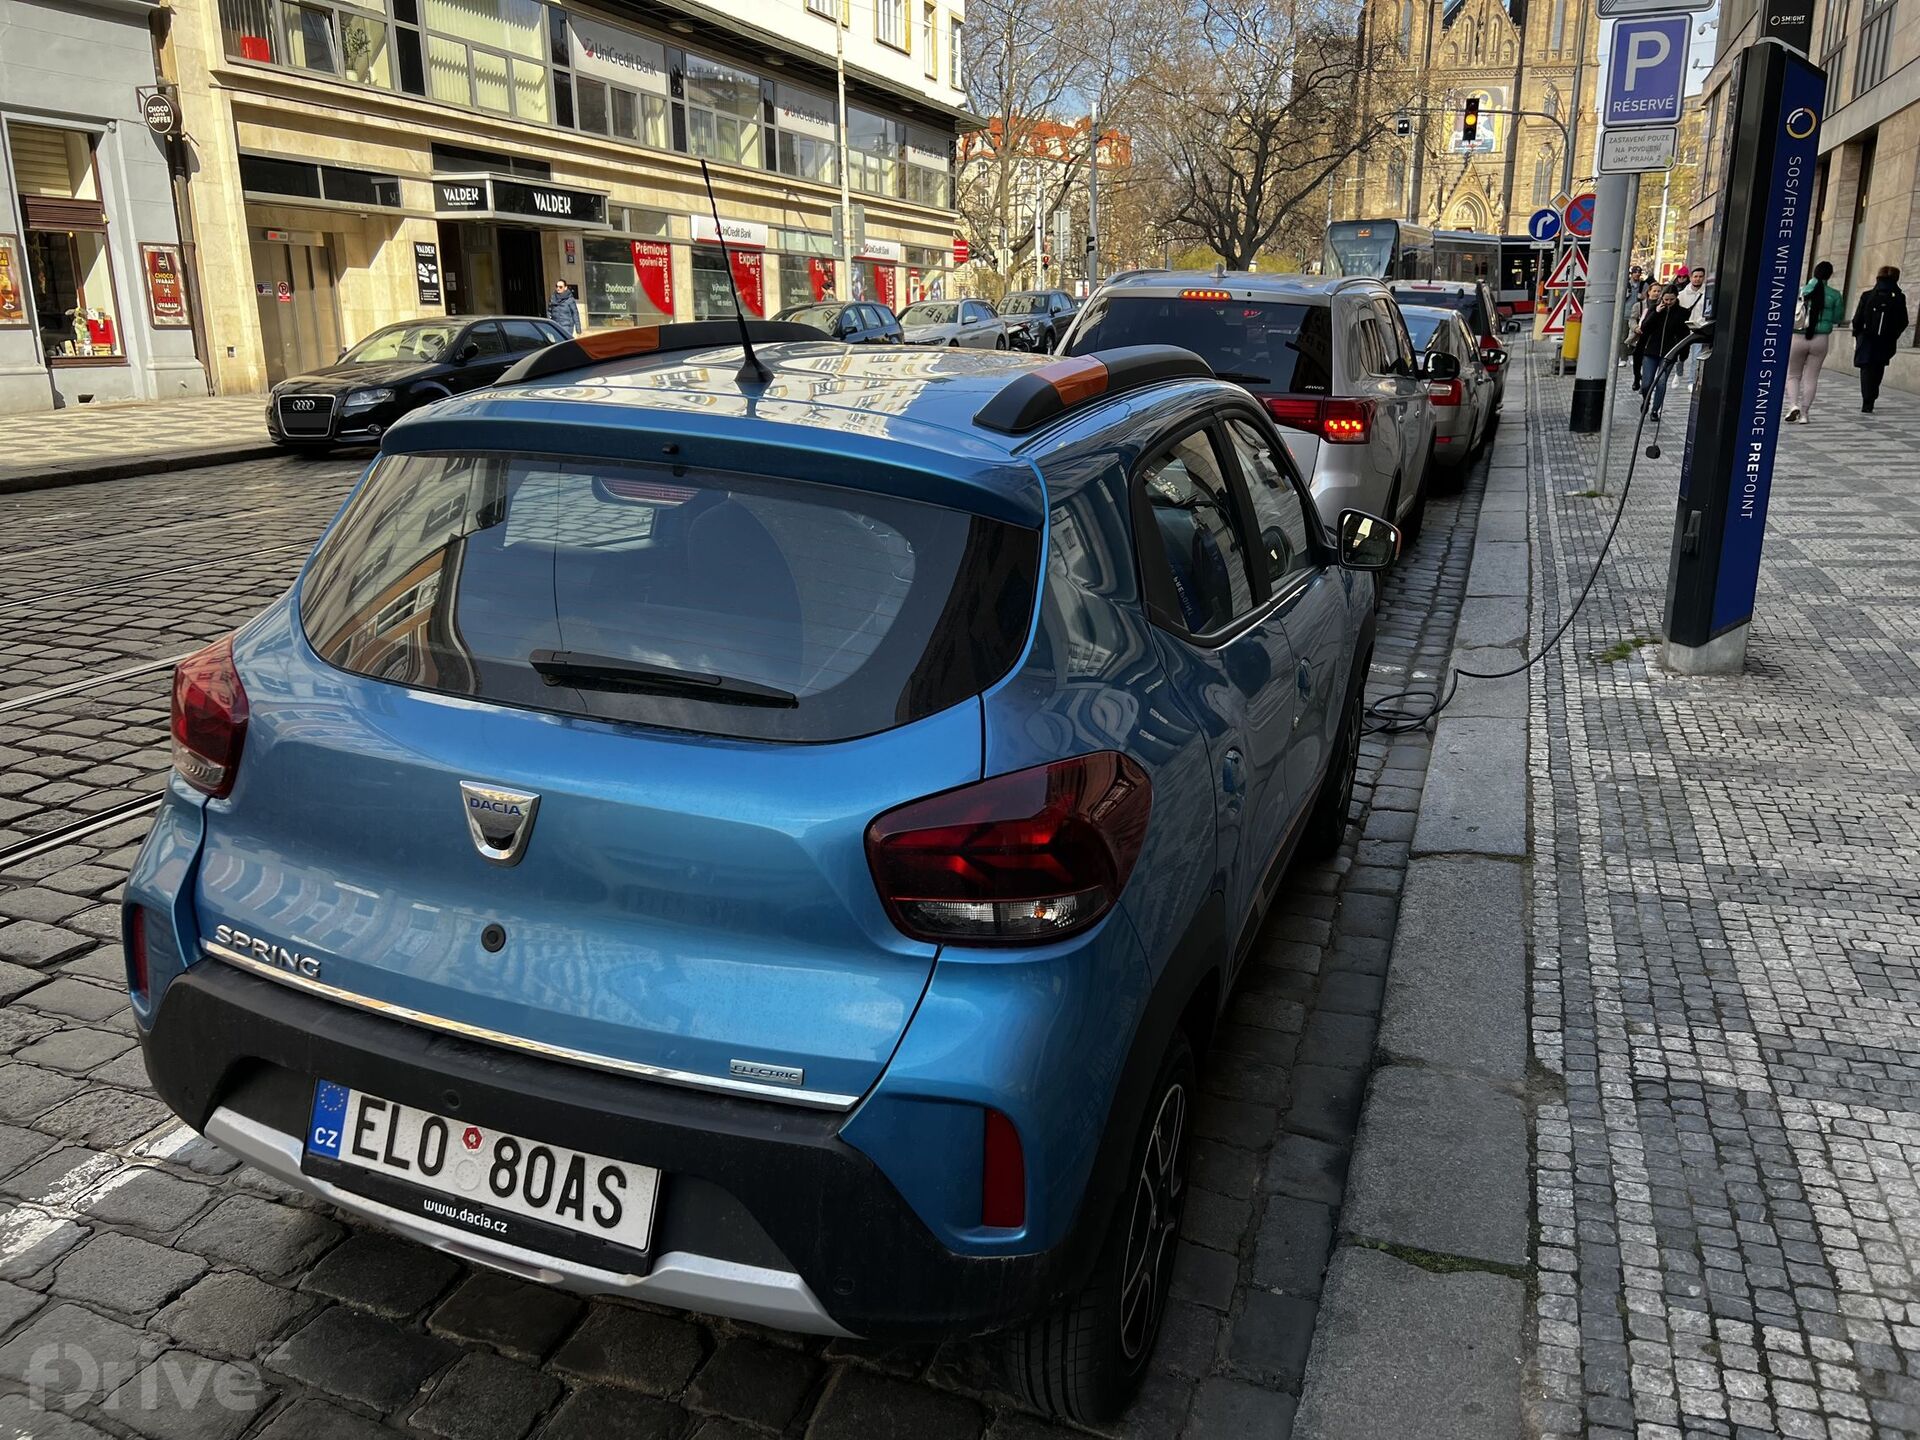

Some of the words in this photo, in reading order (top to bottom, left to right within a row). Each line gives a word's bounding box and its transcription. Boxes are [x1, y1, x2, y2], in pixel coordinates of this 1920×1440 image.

[594, 42, 635, 70] UniCredit
[635, 54, 657, 77] Bank
[1624, 30, 1671, 92] P
[147, 105, 169, 113] CHOCO
[1612, 94, 1675, 113] RÉSERVÉ
[148, 116, 171, 124] COFFEE
[1647, 134, 1670, 142] POUZE
[1631, 154, 1654, 162] PRAHA
[443, 188, 479, 201] VALDEK
[533, 193, 572, 215] VALDEK
[1779, 156, 1802, 238] SOS/FREE
[1751, 369, 1773, 436] STANICE
[1740, 442, 1763, 519] PREPOINT
[470, 797, 522, 816] DACIA
[214, 923, 322, 979] SPRING
[733, 1065, 799, 1080] ELECTRIC
[314, 1126, 339, 1149] CZ
[423, 1198, 508, 1235] www.dacia.cz
